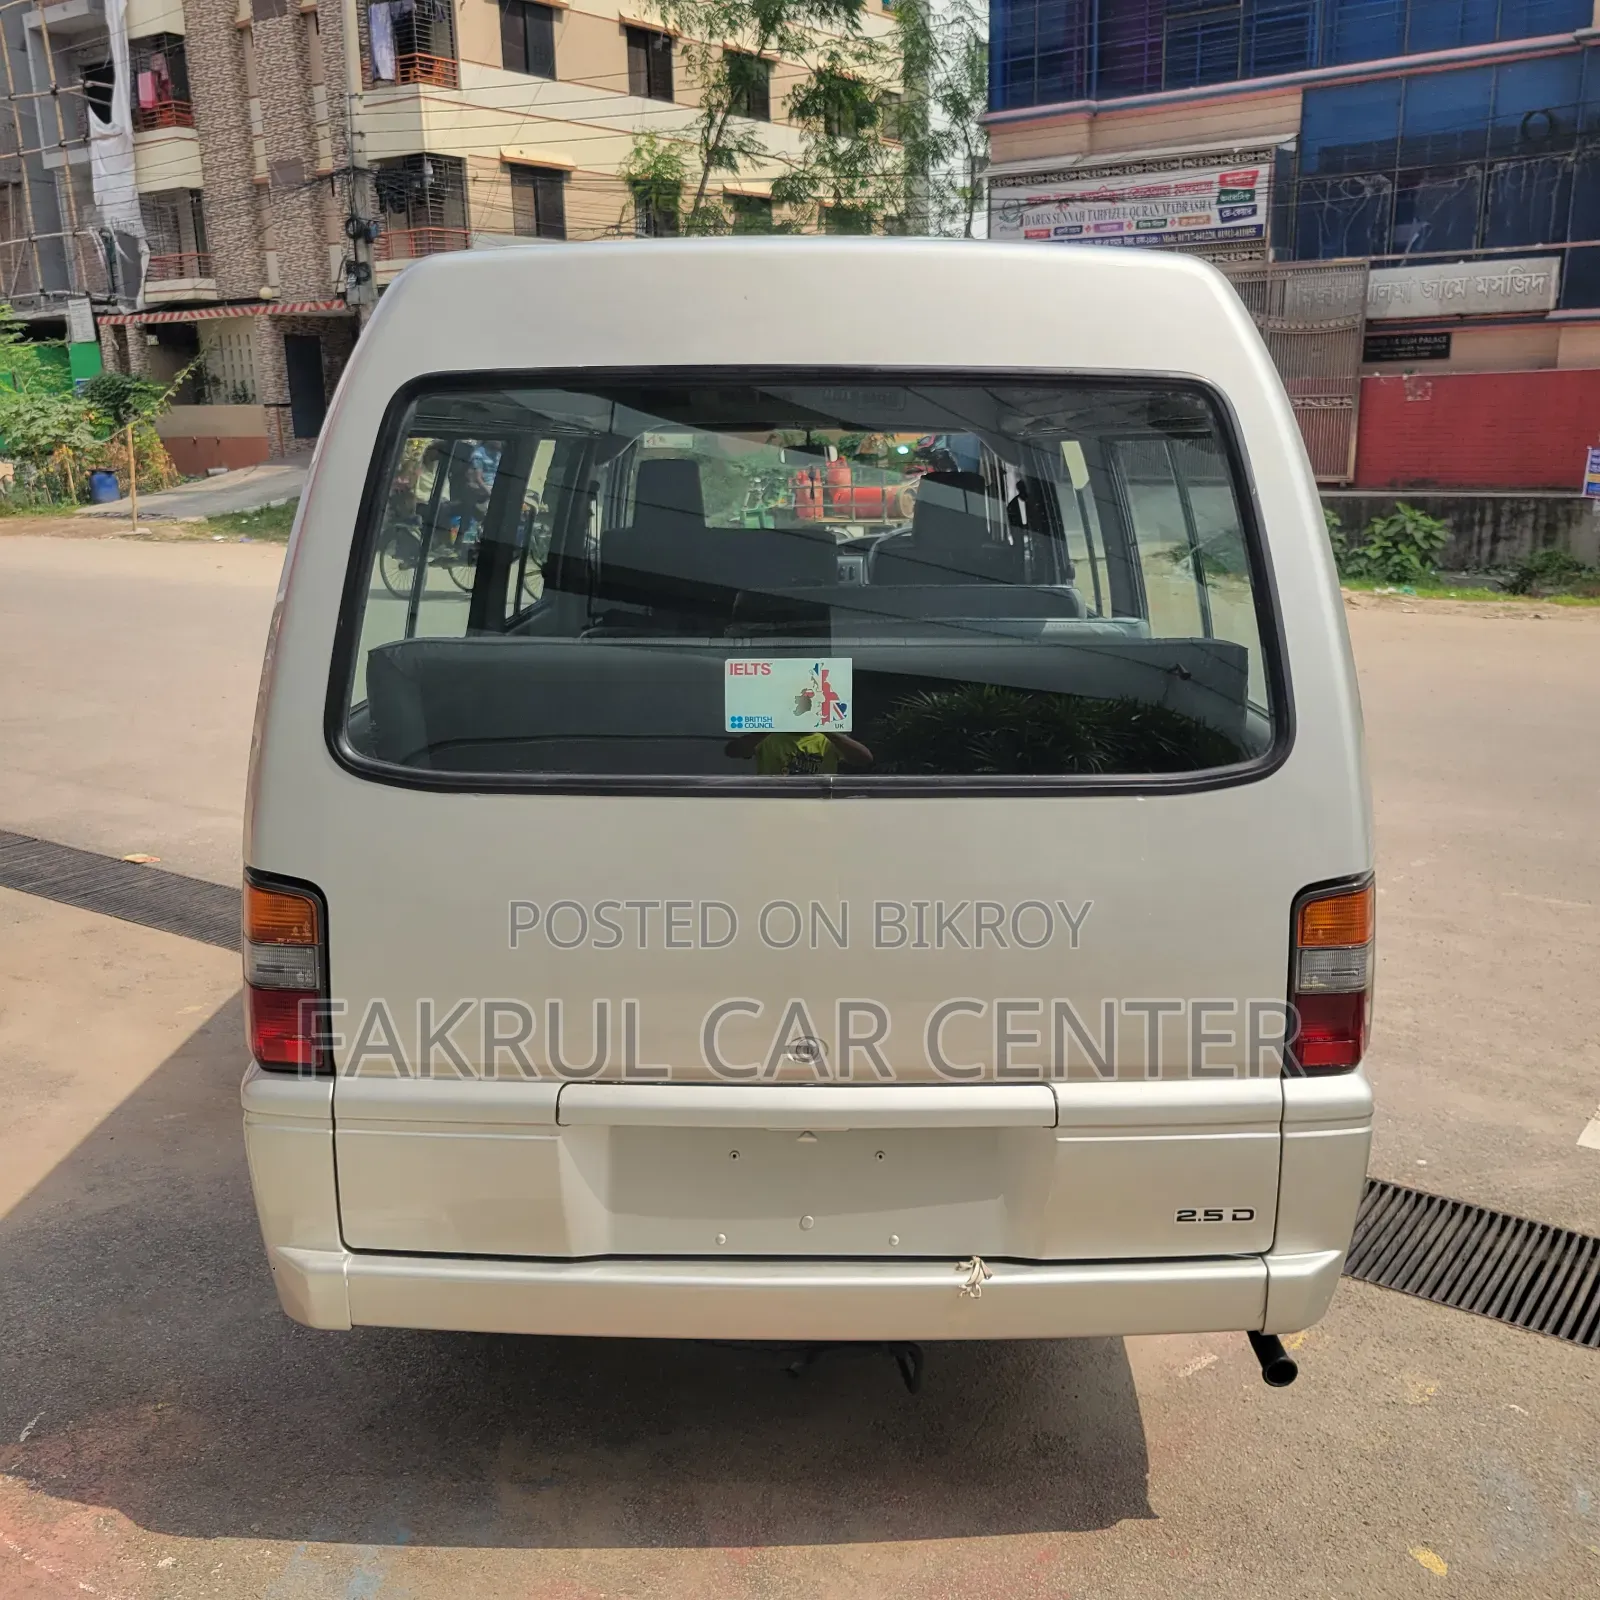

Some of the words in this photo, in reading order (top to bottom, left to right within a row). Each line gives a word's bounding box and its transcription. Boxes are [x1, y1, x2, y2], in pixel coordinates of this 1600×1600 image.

[1052, 209, 1085, 226] SUNNAH
[1129, 202, 1160, 219] QURAN
[1419, 274, 1469, 300] জামে
[1471, 265, 1549, 298] মসজিদ
[1420, 335, 1447, 344] PALACE
[729, 662, 772, 676] IELTS
[1176, 1209, 1224, 1222] 2.5
[1231, 1208, 1255, 1222] D
